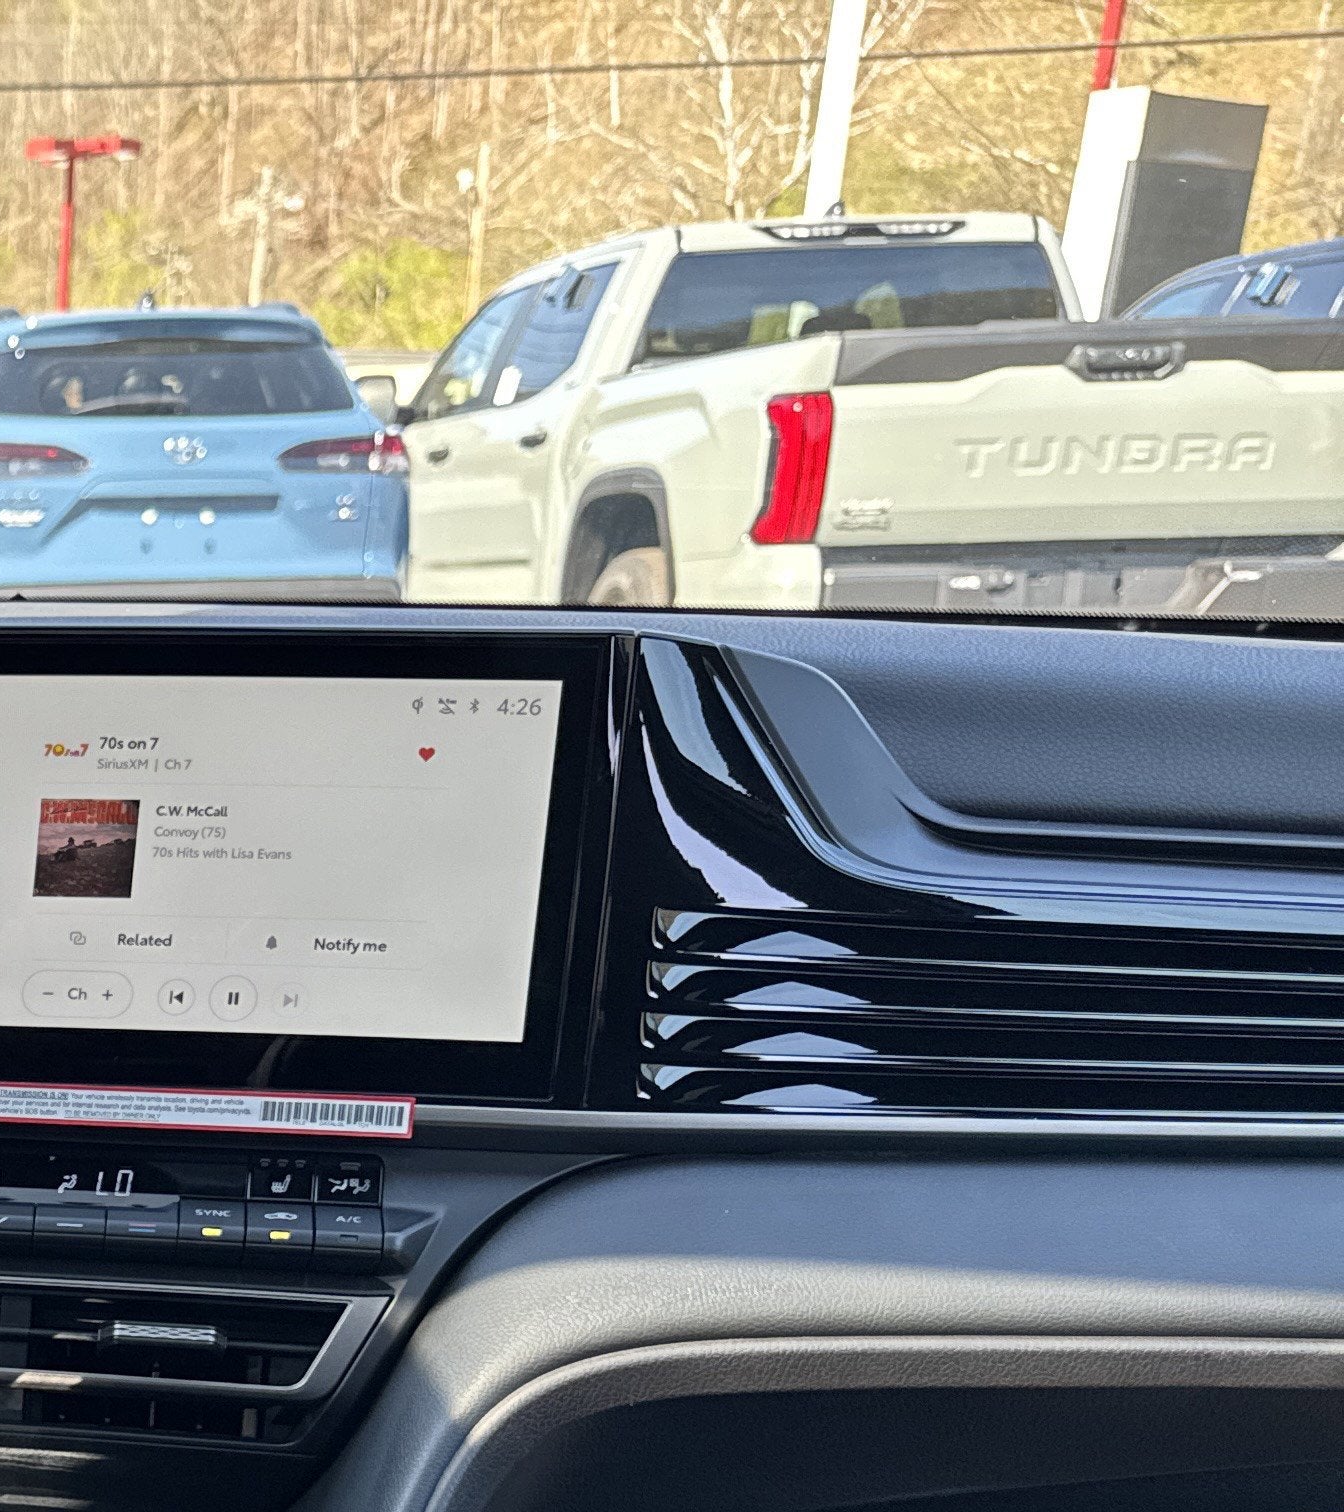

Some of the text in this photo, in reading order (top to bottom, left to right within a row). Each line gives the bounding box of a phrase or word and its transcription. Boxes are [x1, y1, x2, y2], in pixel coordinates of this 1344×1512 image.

[954, 430, 1277, 478] TUNDRA
[496, 698, 542, 716] 4:26
[100, 736, 160, 750] 70s on 7
[97, 758, 192, 771] SiriusXM Ch 7
[153, 805, 228, 817] C.W. McCall
[154, 826, 227, 840] Convoy (75)
[152, 846, 292, 860] 70s Hits with Lisa Evans
[117, 933, 173, 947] Related
[313, 938, 388, 955] Notify me
[67, 988, 88, 1001] Ch
[95, 1169, 134, 1197] LO
[195, 1208, 232, 1218] SYNC
[336, 1215, 362, 1224] A/C
